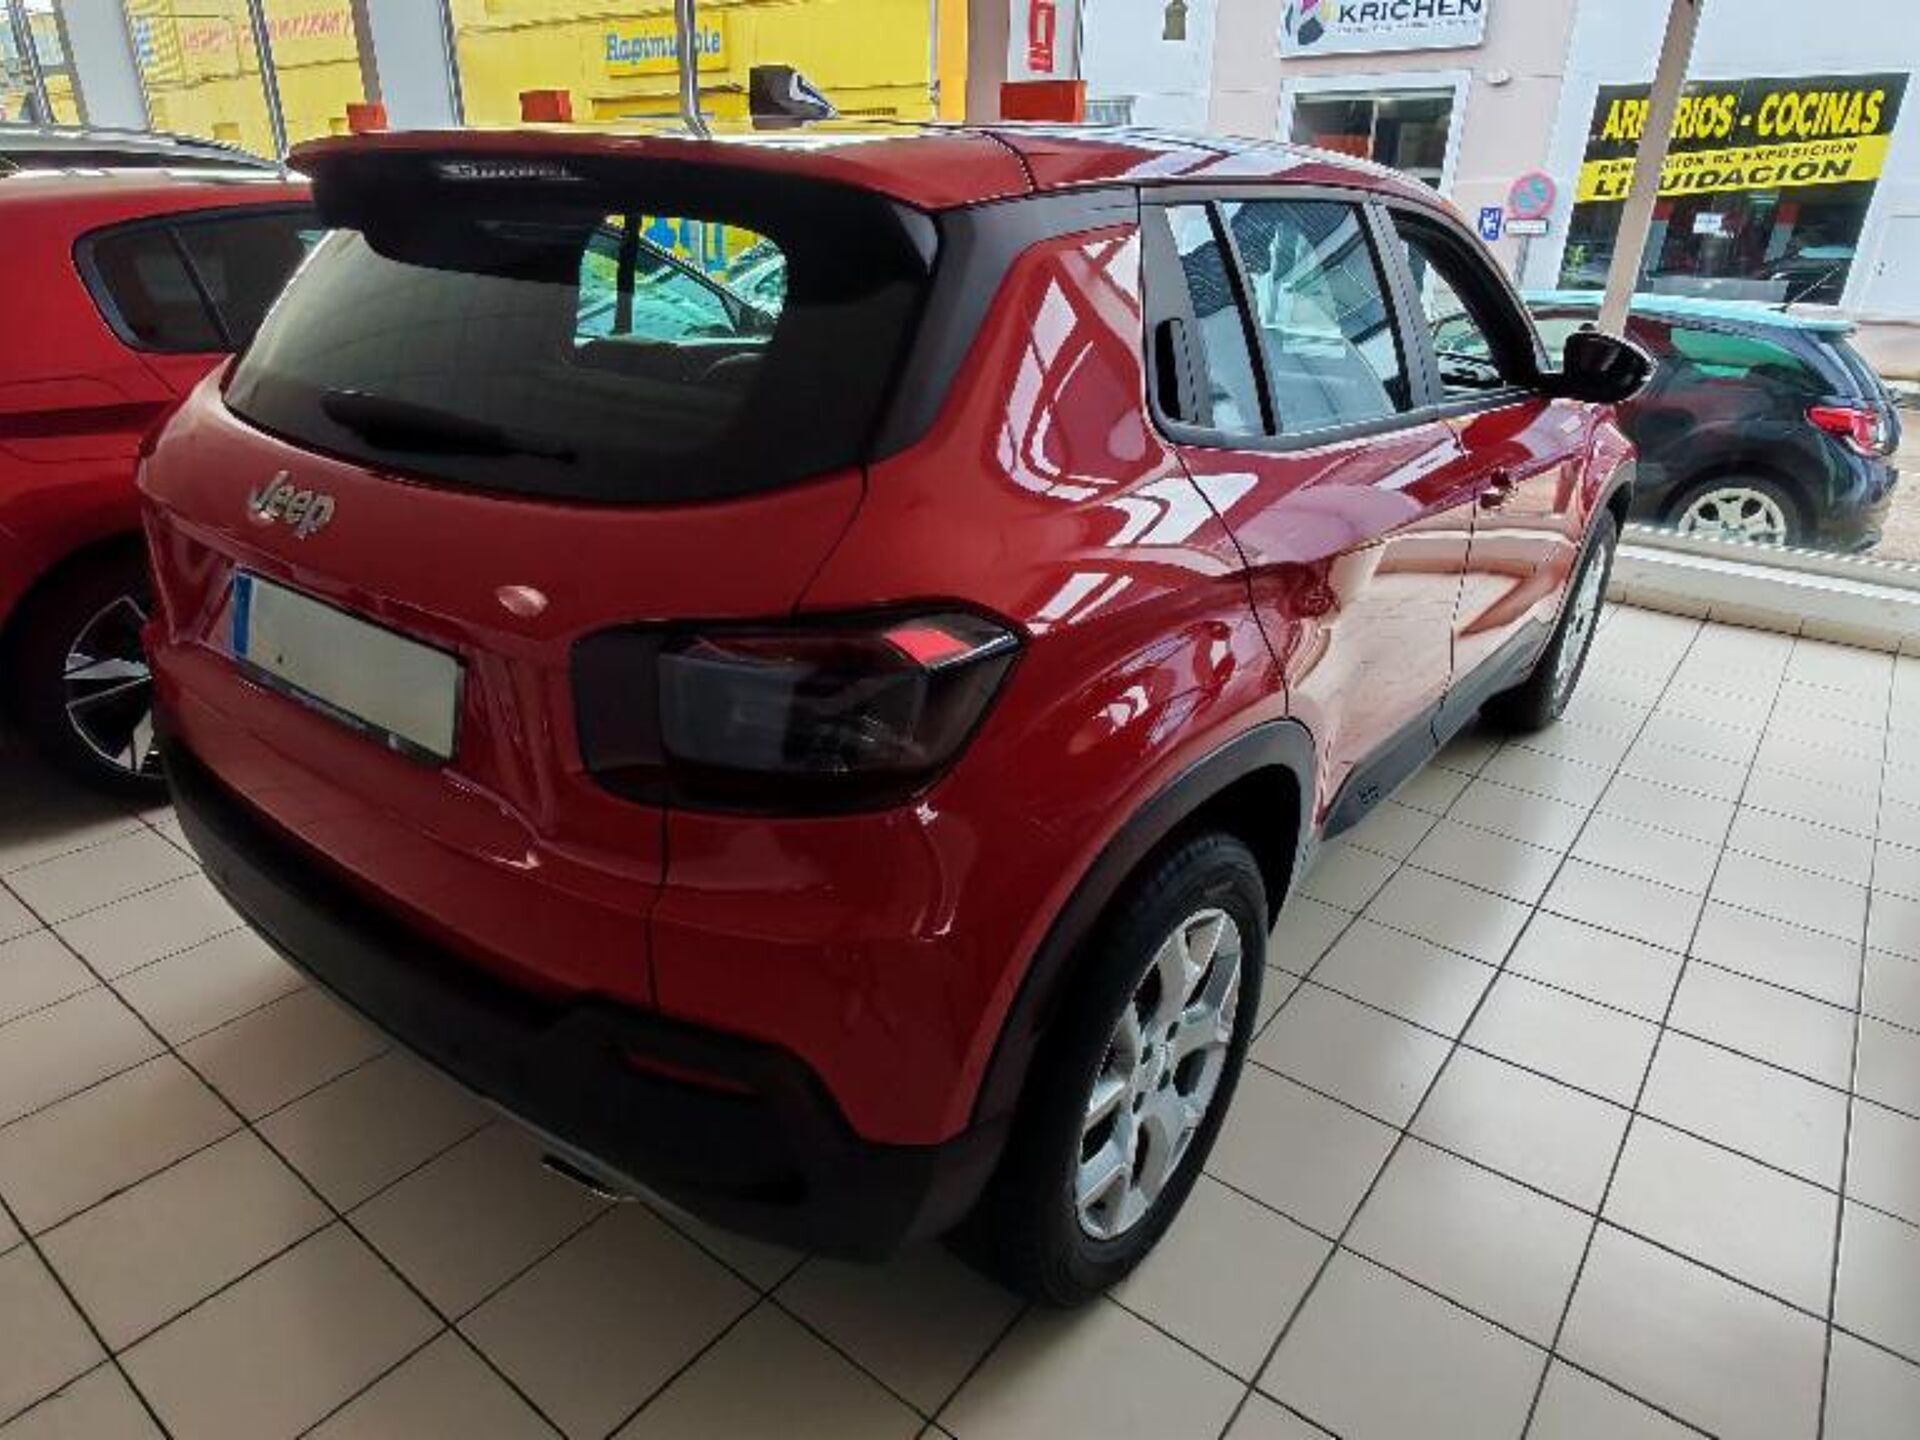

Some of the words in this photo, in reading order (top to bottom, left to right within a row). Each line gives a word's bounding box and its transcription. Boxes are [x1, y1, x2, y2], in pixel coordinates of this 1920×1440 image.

[1338, 0, 1482, 23] KRICHEN
[1758, 89, 1885, 136] COCINAS
[249, 469, 336, 541] Jeep
